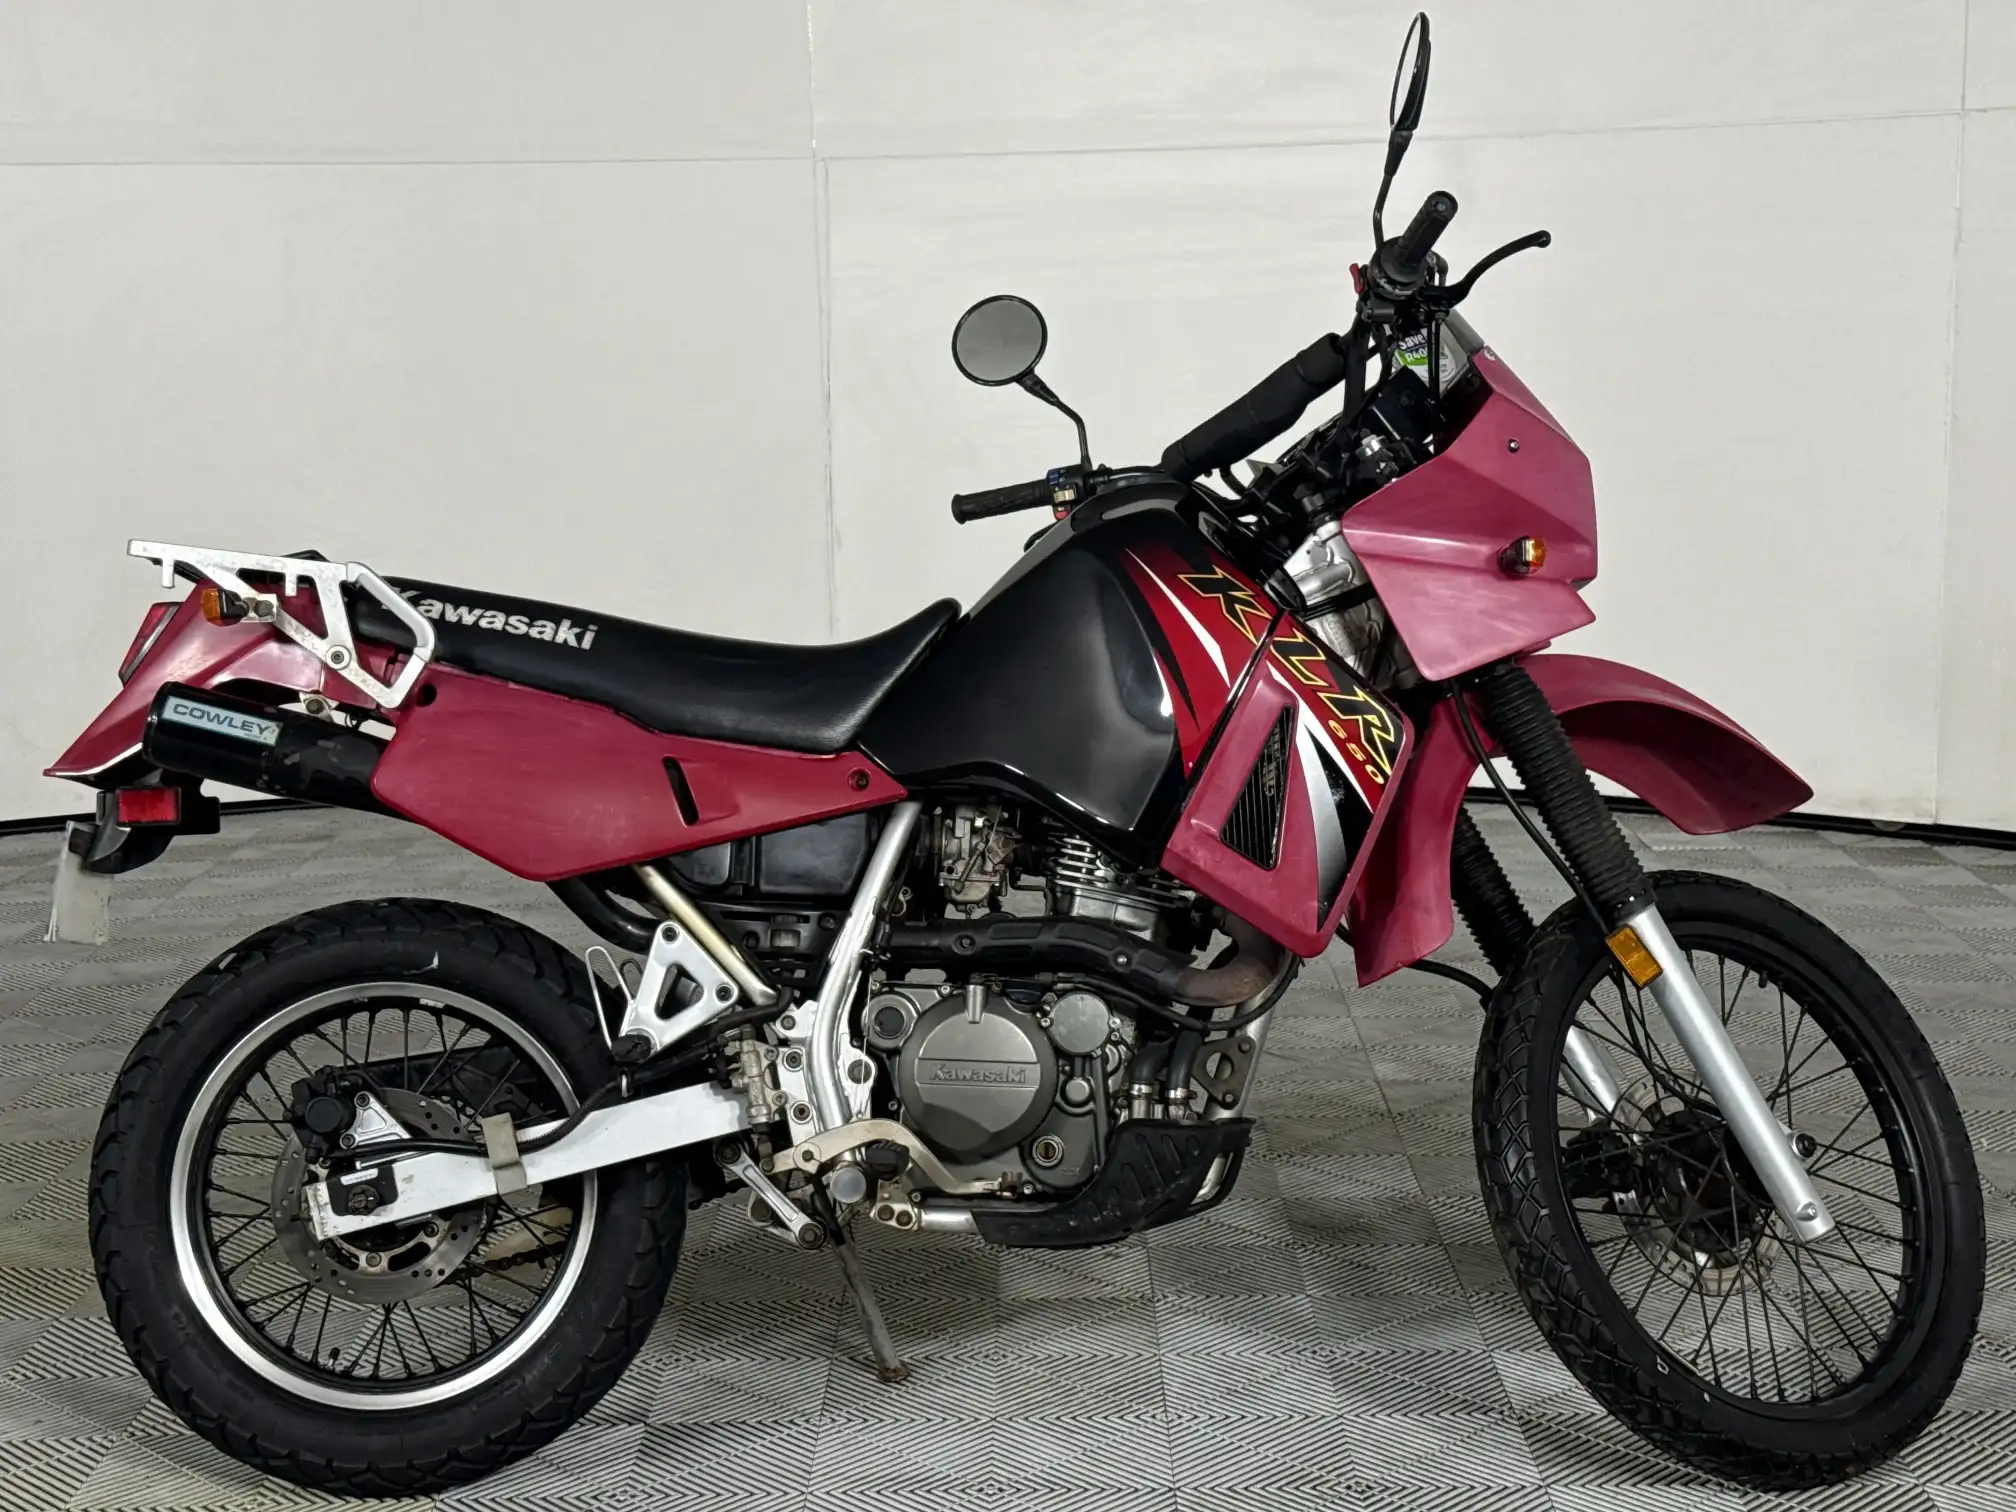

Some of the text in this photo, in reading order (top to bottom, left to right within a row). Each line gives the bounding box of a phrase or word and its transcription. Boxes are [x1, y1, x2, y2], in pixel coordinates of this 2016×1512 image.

[1398, 334, 1426, 350] Save
[1177, 564, 1394, 776] KLR
[173, 703, 271, 735] COWLEY
[1328, 719, 1385, 785] 650
[929, 1062, 1026, 1083] Kawasaki
